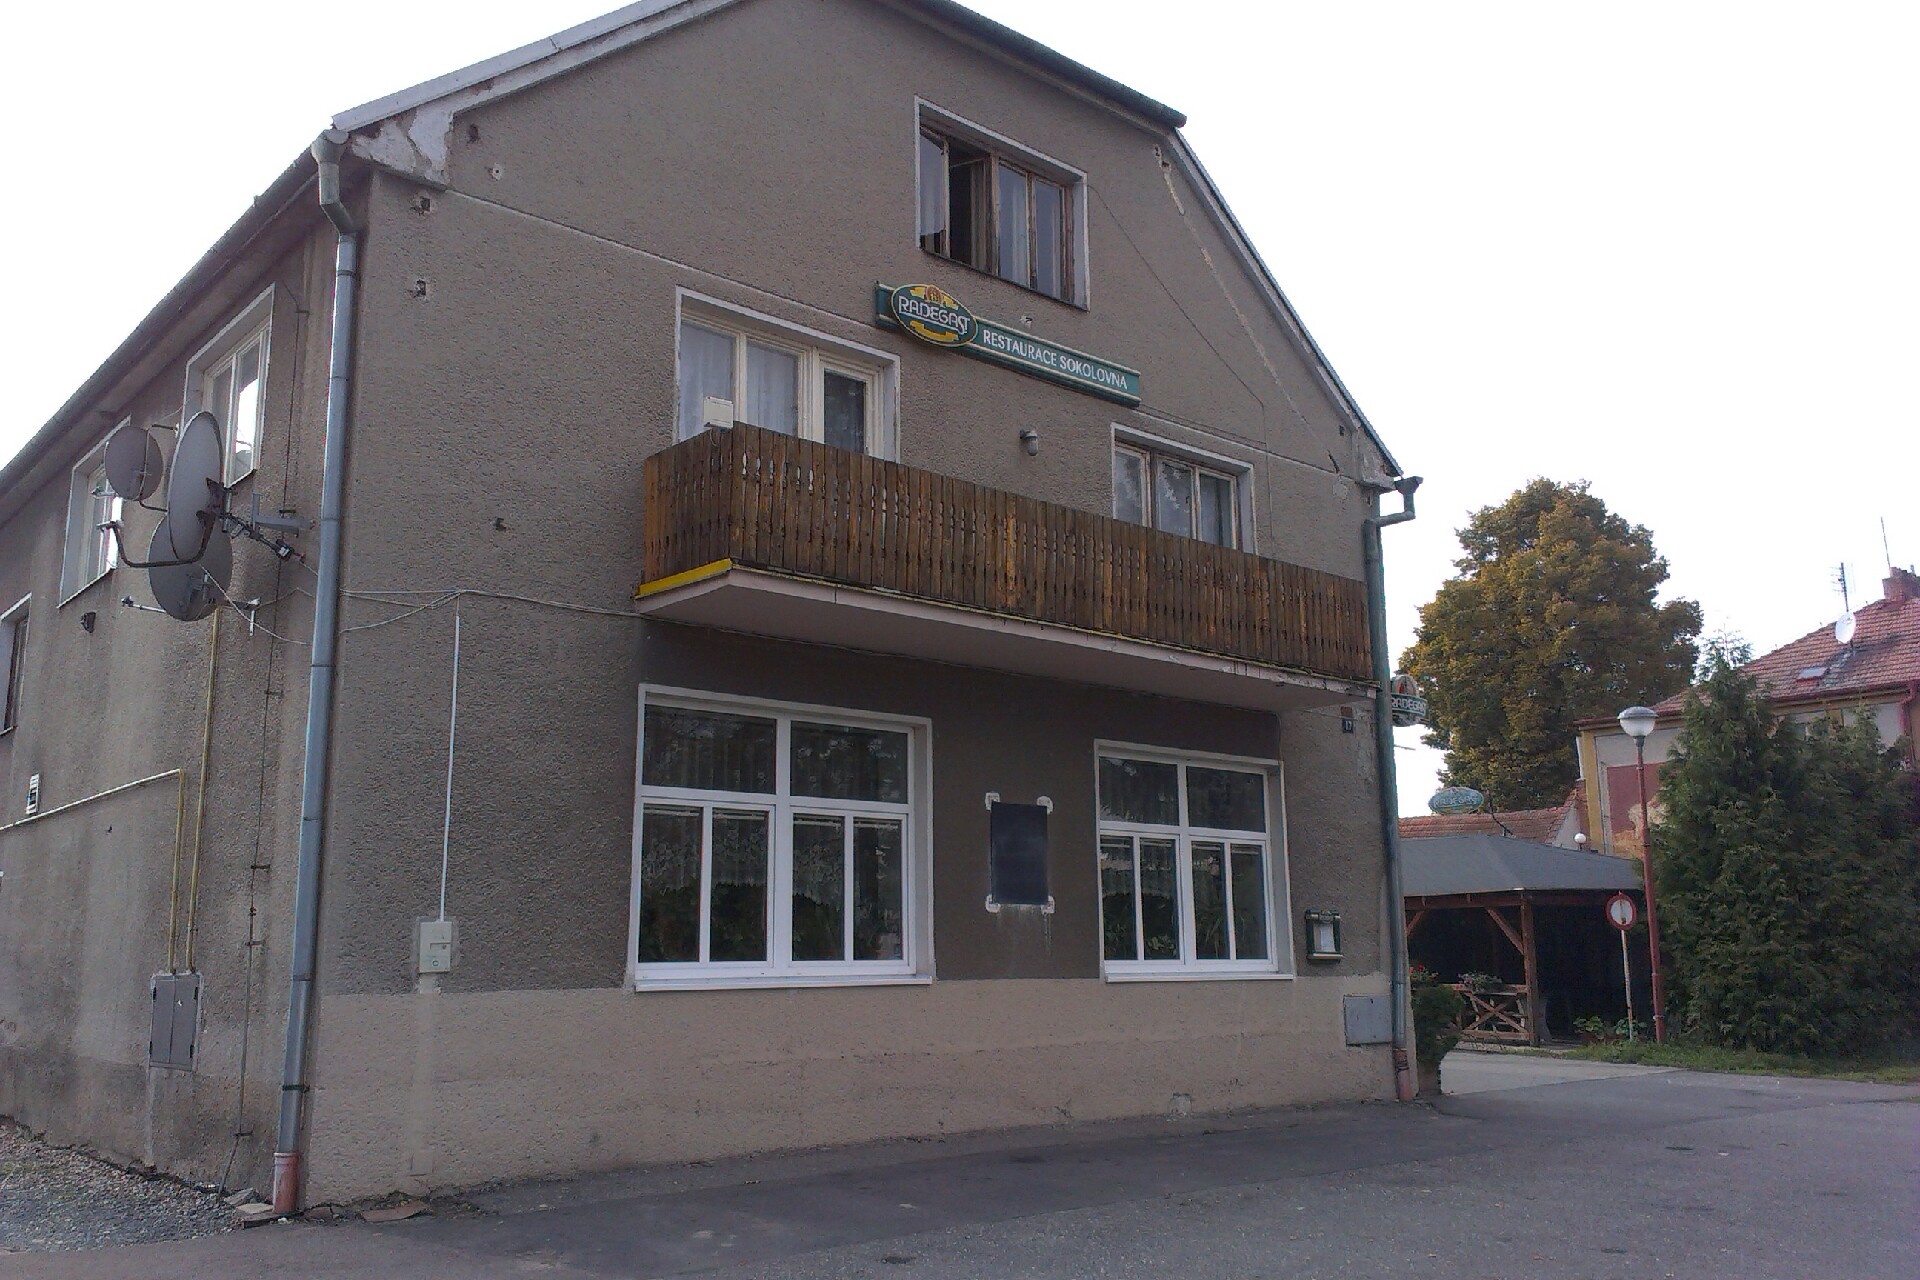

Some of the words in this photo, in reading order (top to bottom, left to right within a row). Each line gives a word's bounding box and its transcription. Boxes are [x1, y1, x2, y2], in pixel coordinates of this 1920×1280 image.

[898, 296, 971, 335] RADEGAST
[983, 329, 1057, 367] RESTAURACE
[1059, 355, 1128, 390] SOKOLOVNA
